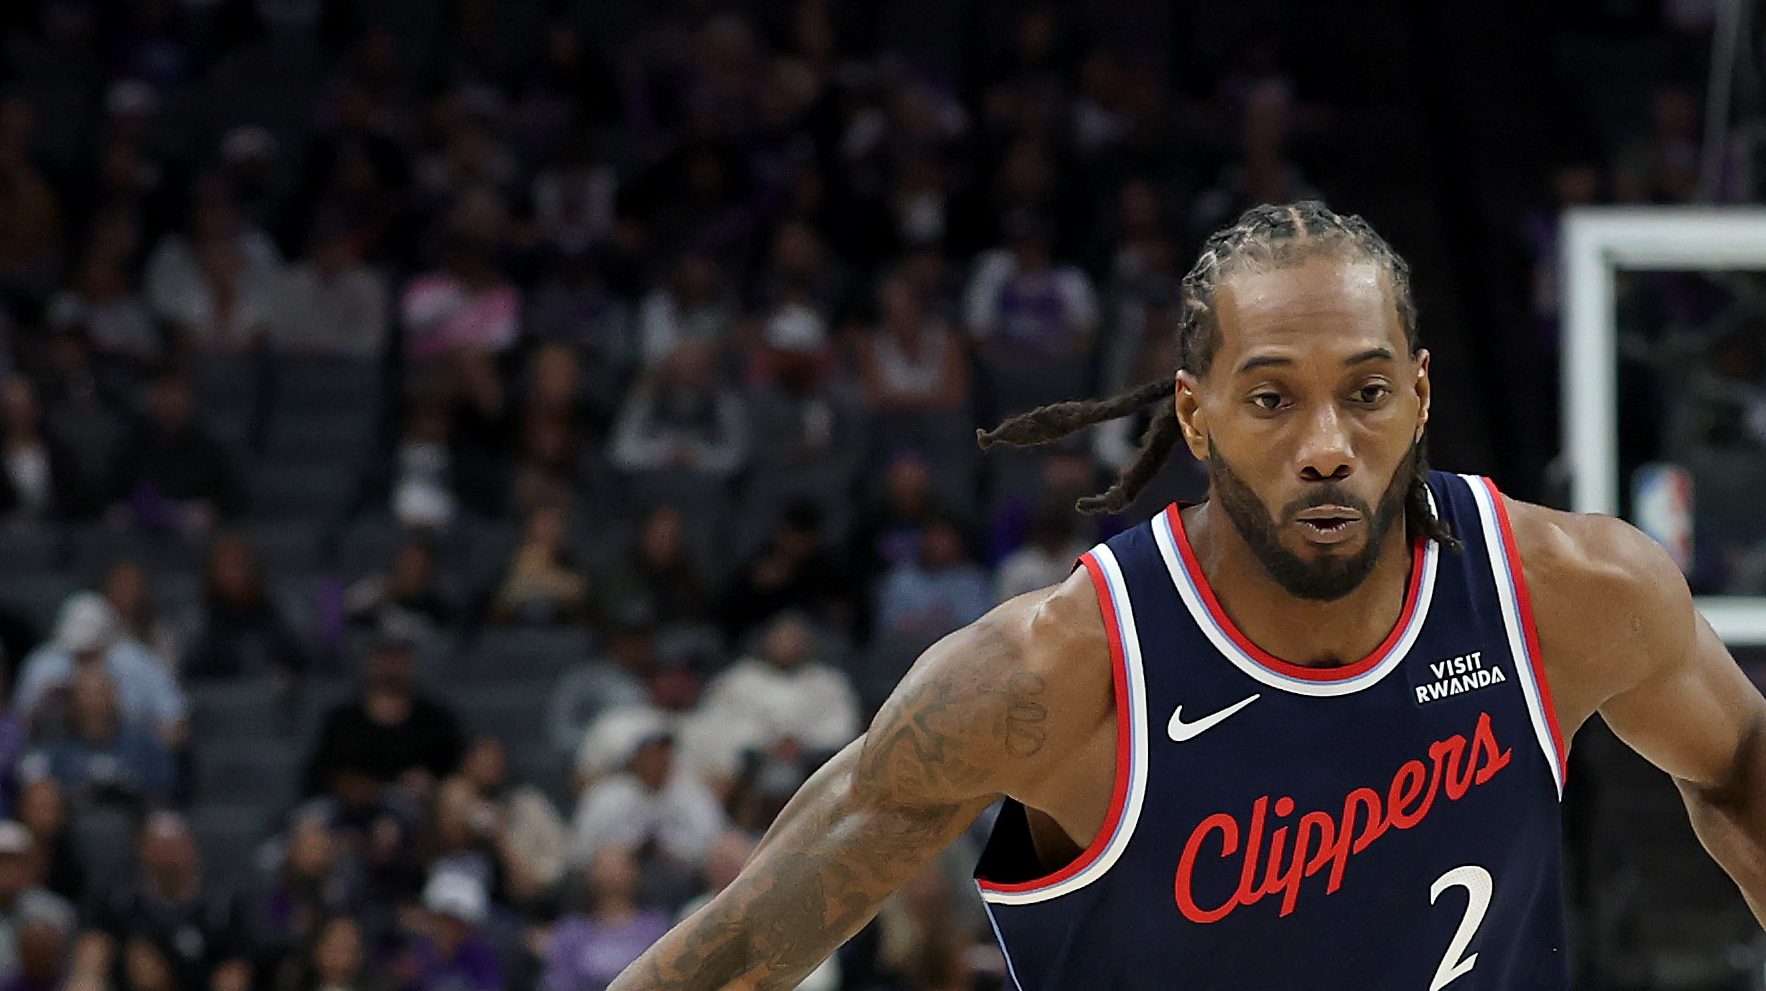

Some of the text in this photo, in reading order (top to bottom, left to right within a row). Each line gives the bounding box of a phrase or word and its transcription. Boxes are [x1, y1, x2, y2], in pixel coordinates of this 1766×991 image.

[1430, 652, 1481, 679] VISIT
[1415, 666, 1506, 704] RWANDA
[1174, 711, 1512, 923] Clippers
